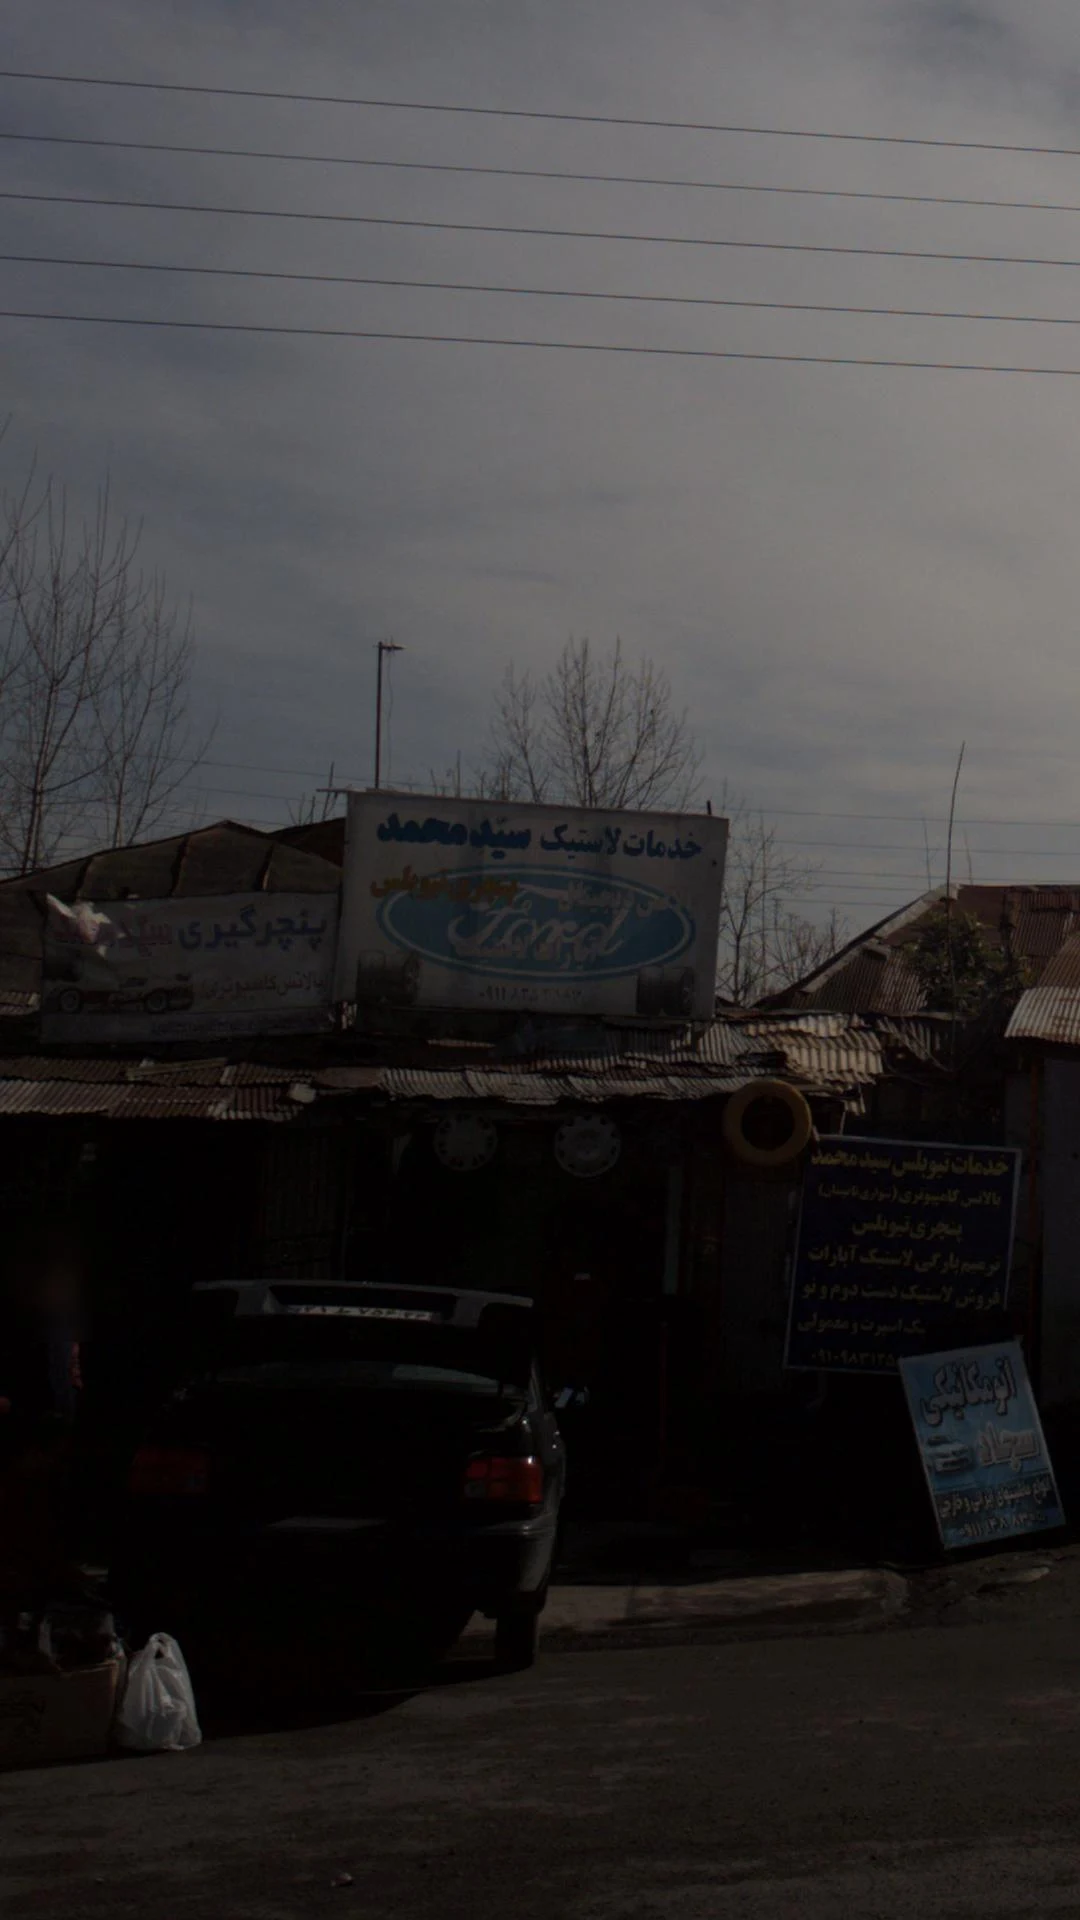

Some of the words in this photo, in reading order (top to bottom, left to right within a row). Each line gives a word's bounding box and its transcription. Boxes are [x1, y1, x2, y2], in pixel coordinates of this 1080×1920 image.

[377, 812, 468, 847] محمد
[540, 823, 622, 861] لاستیک
[622, 829, 703, 861] خدمات
[447, 884, 634, 958] Ford
[811, 1148, 860, 1169] محمد
[860, 1150, 892, 1176] سید
[892, 1150, 952, 1180] تیوبلس
[951, 1151, 1009, 1177] خدمات
[960, 1190, 1001, 1208] بالانس
[859, 1247, 913, 1270] لاستیک
[900, 1284, 953, 1306] لاستیک
[955, 1287, 1001, 1311] فروش
[920, 1355, 1018, 1428] اتومکانیکی
